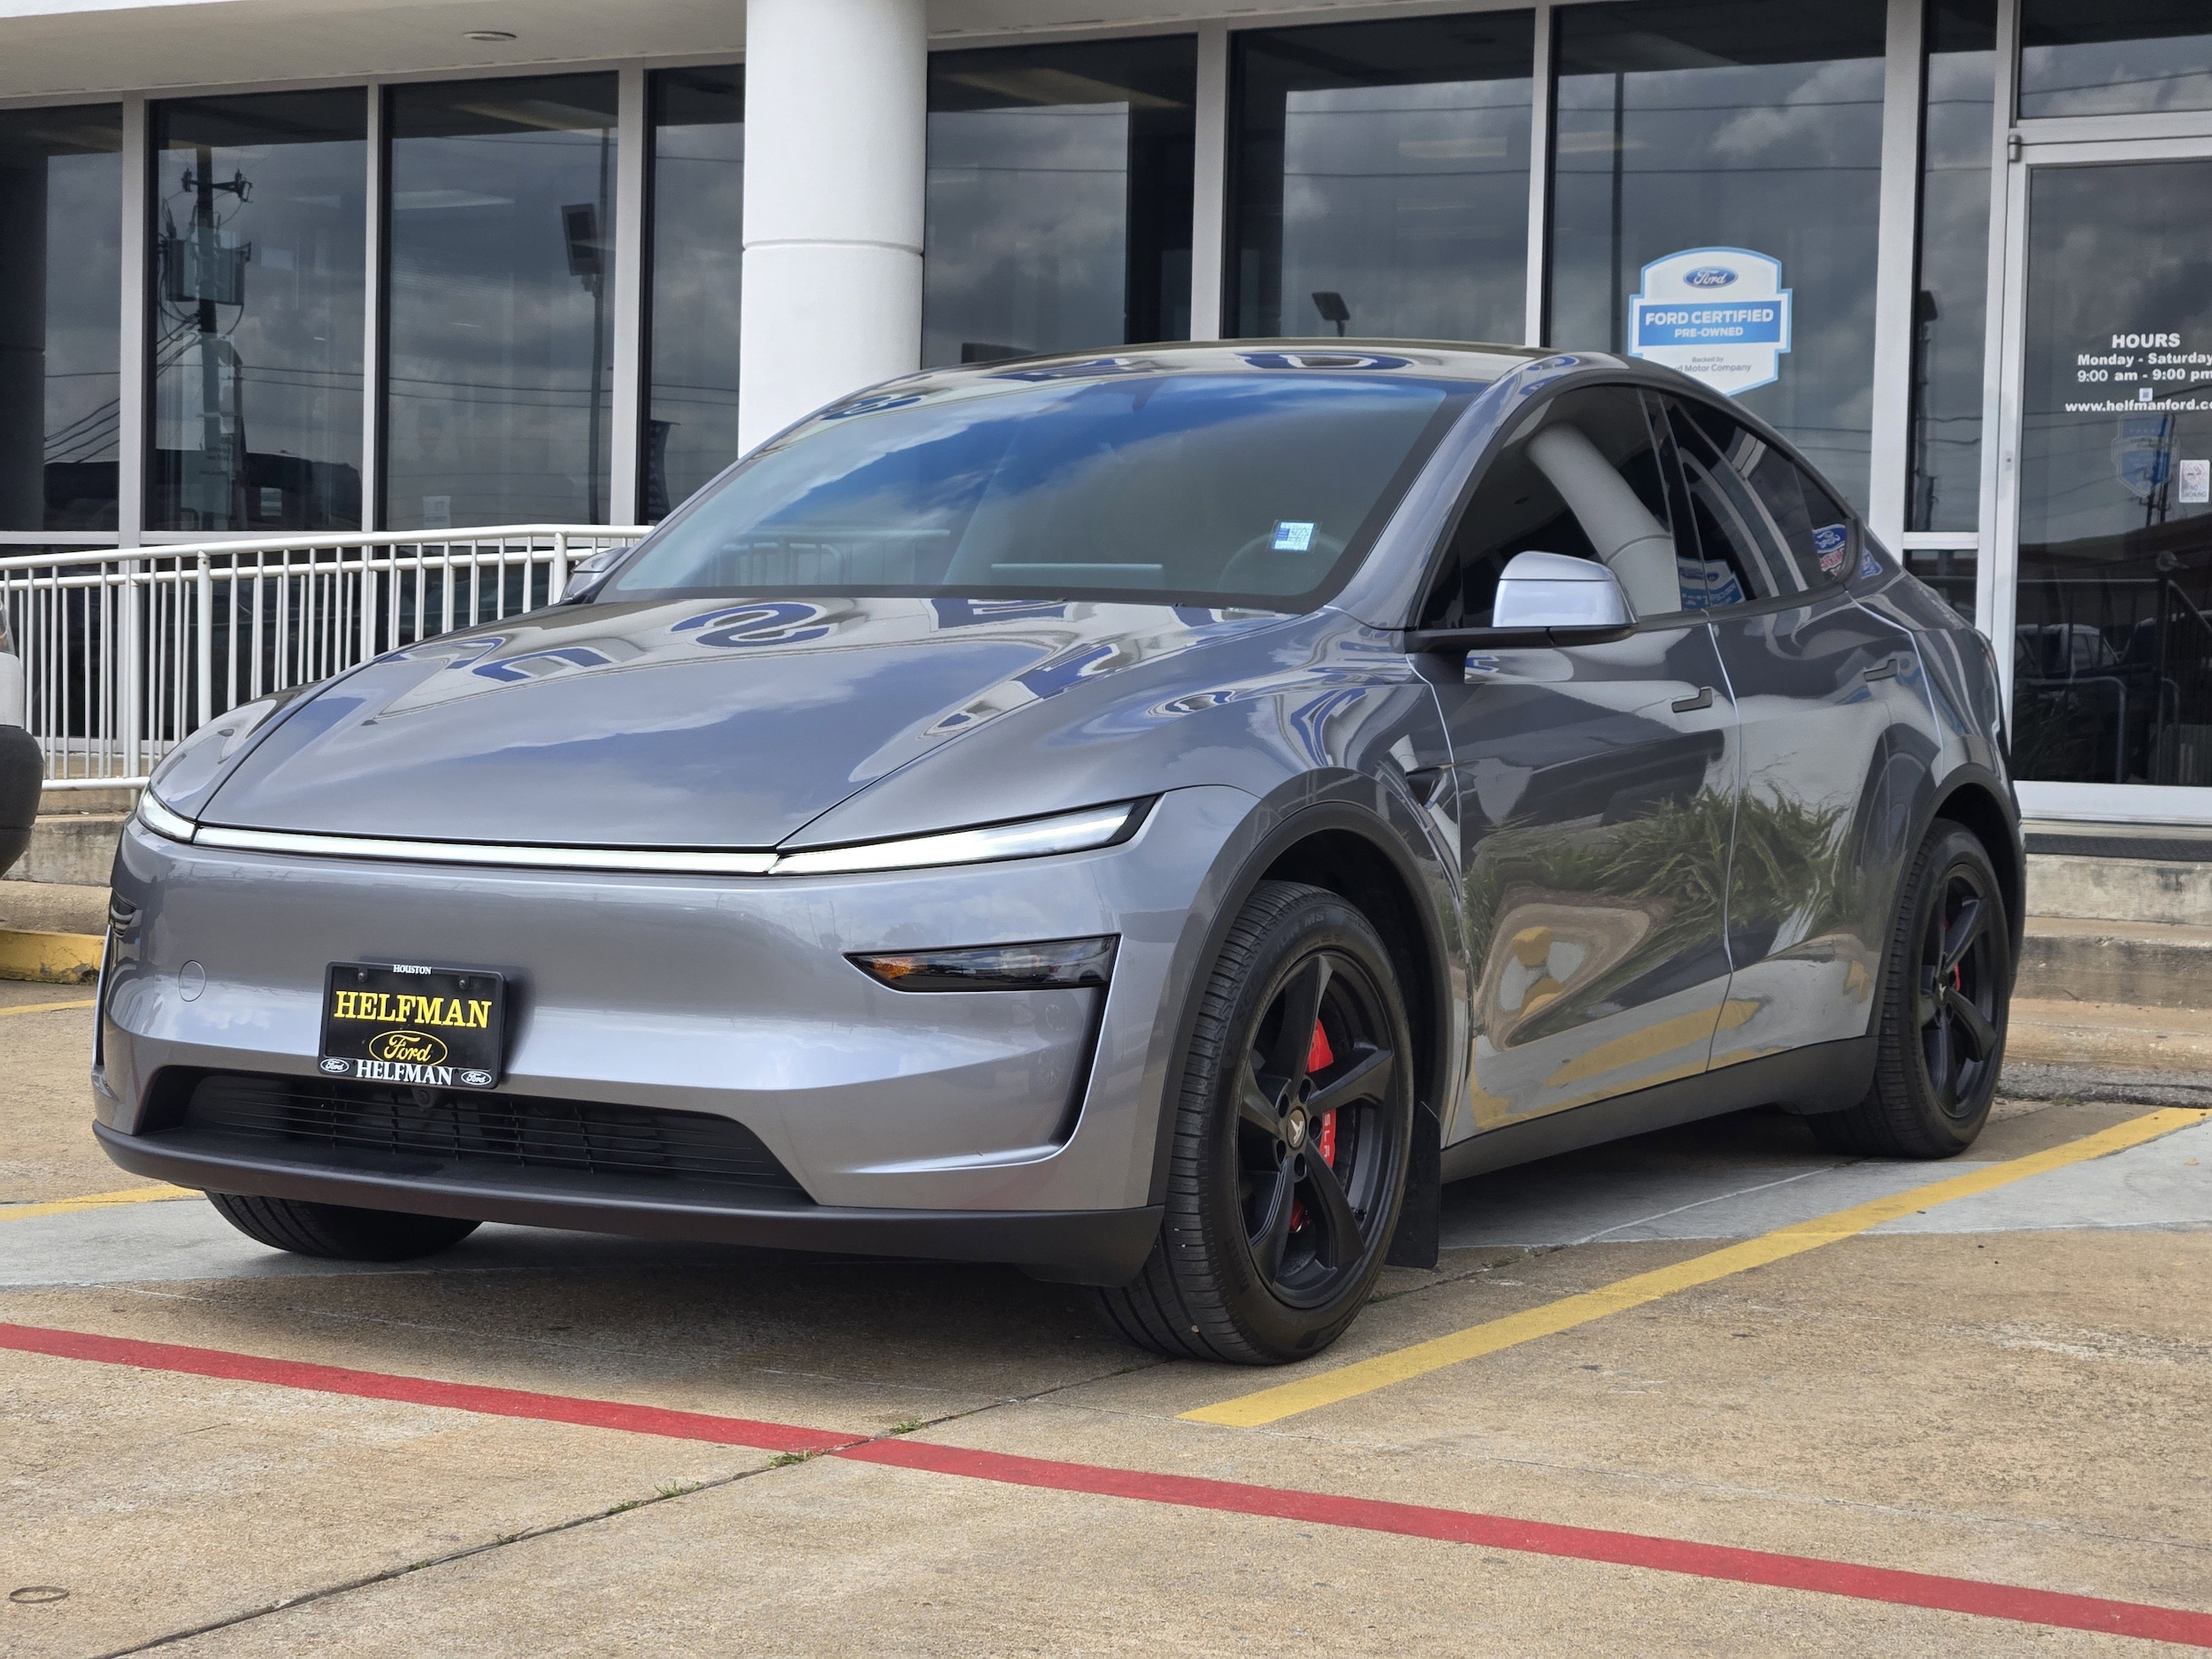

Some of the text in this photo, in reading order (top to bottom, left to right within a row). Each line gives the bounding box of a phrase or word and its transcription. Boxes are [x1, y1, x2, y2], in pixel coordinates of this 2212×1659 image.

[1694, 270, 1727, 285] Ford
[1645, 309, 1774, 326] FORD CERTIFIED
[1674, 326, 1744, 338] PRE-OWNED
[2112, 333, 2180, 348] HOURS
[2078, 354, 2134, 367] Monday
[2147, 351, 2212, 365] Saturday
[2078, 369, 2108, 382] 9:00
[2114, 372, 2138, 381] am
[2152, 368, 2185, 380] 9:00
[2190, 370, 2212, 382] pm
[2065, 398, 2212, 411] www.helfmanford.c
[393, 964, 432, 975] HOUSTON
[334, 990, 492, 1028] HELFMAN
[383, 1033, 433, 1062] Ford
[325, 1059, 487, 1086] Ford HELFMAN Ford
